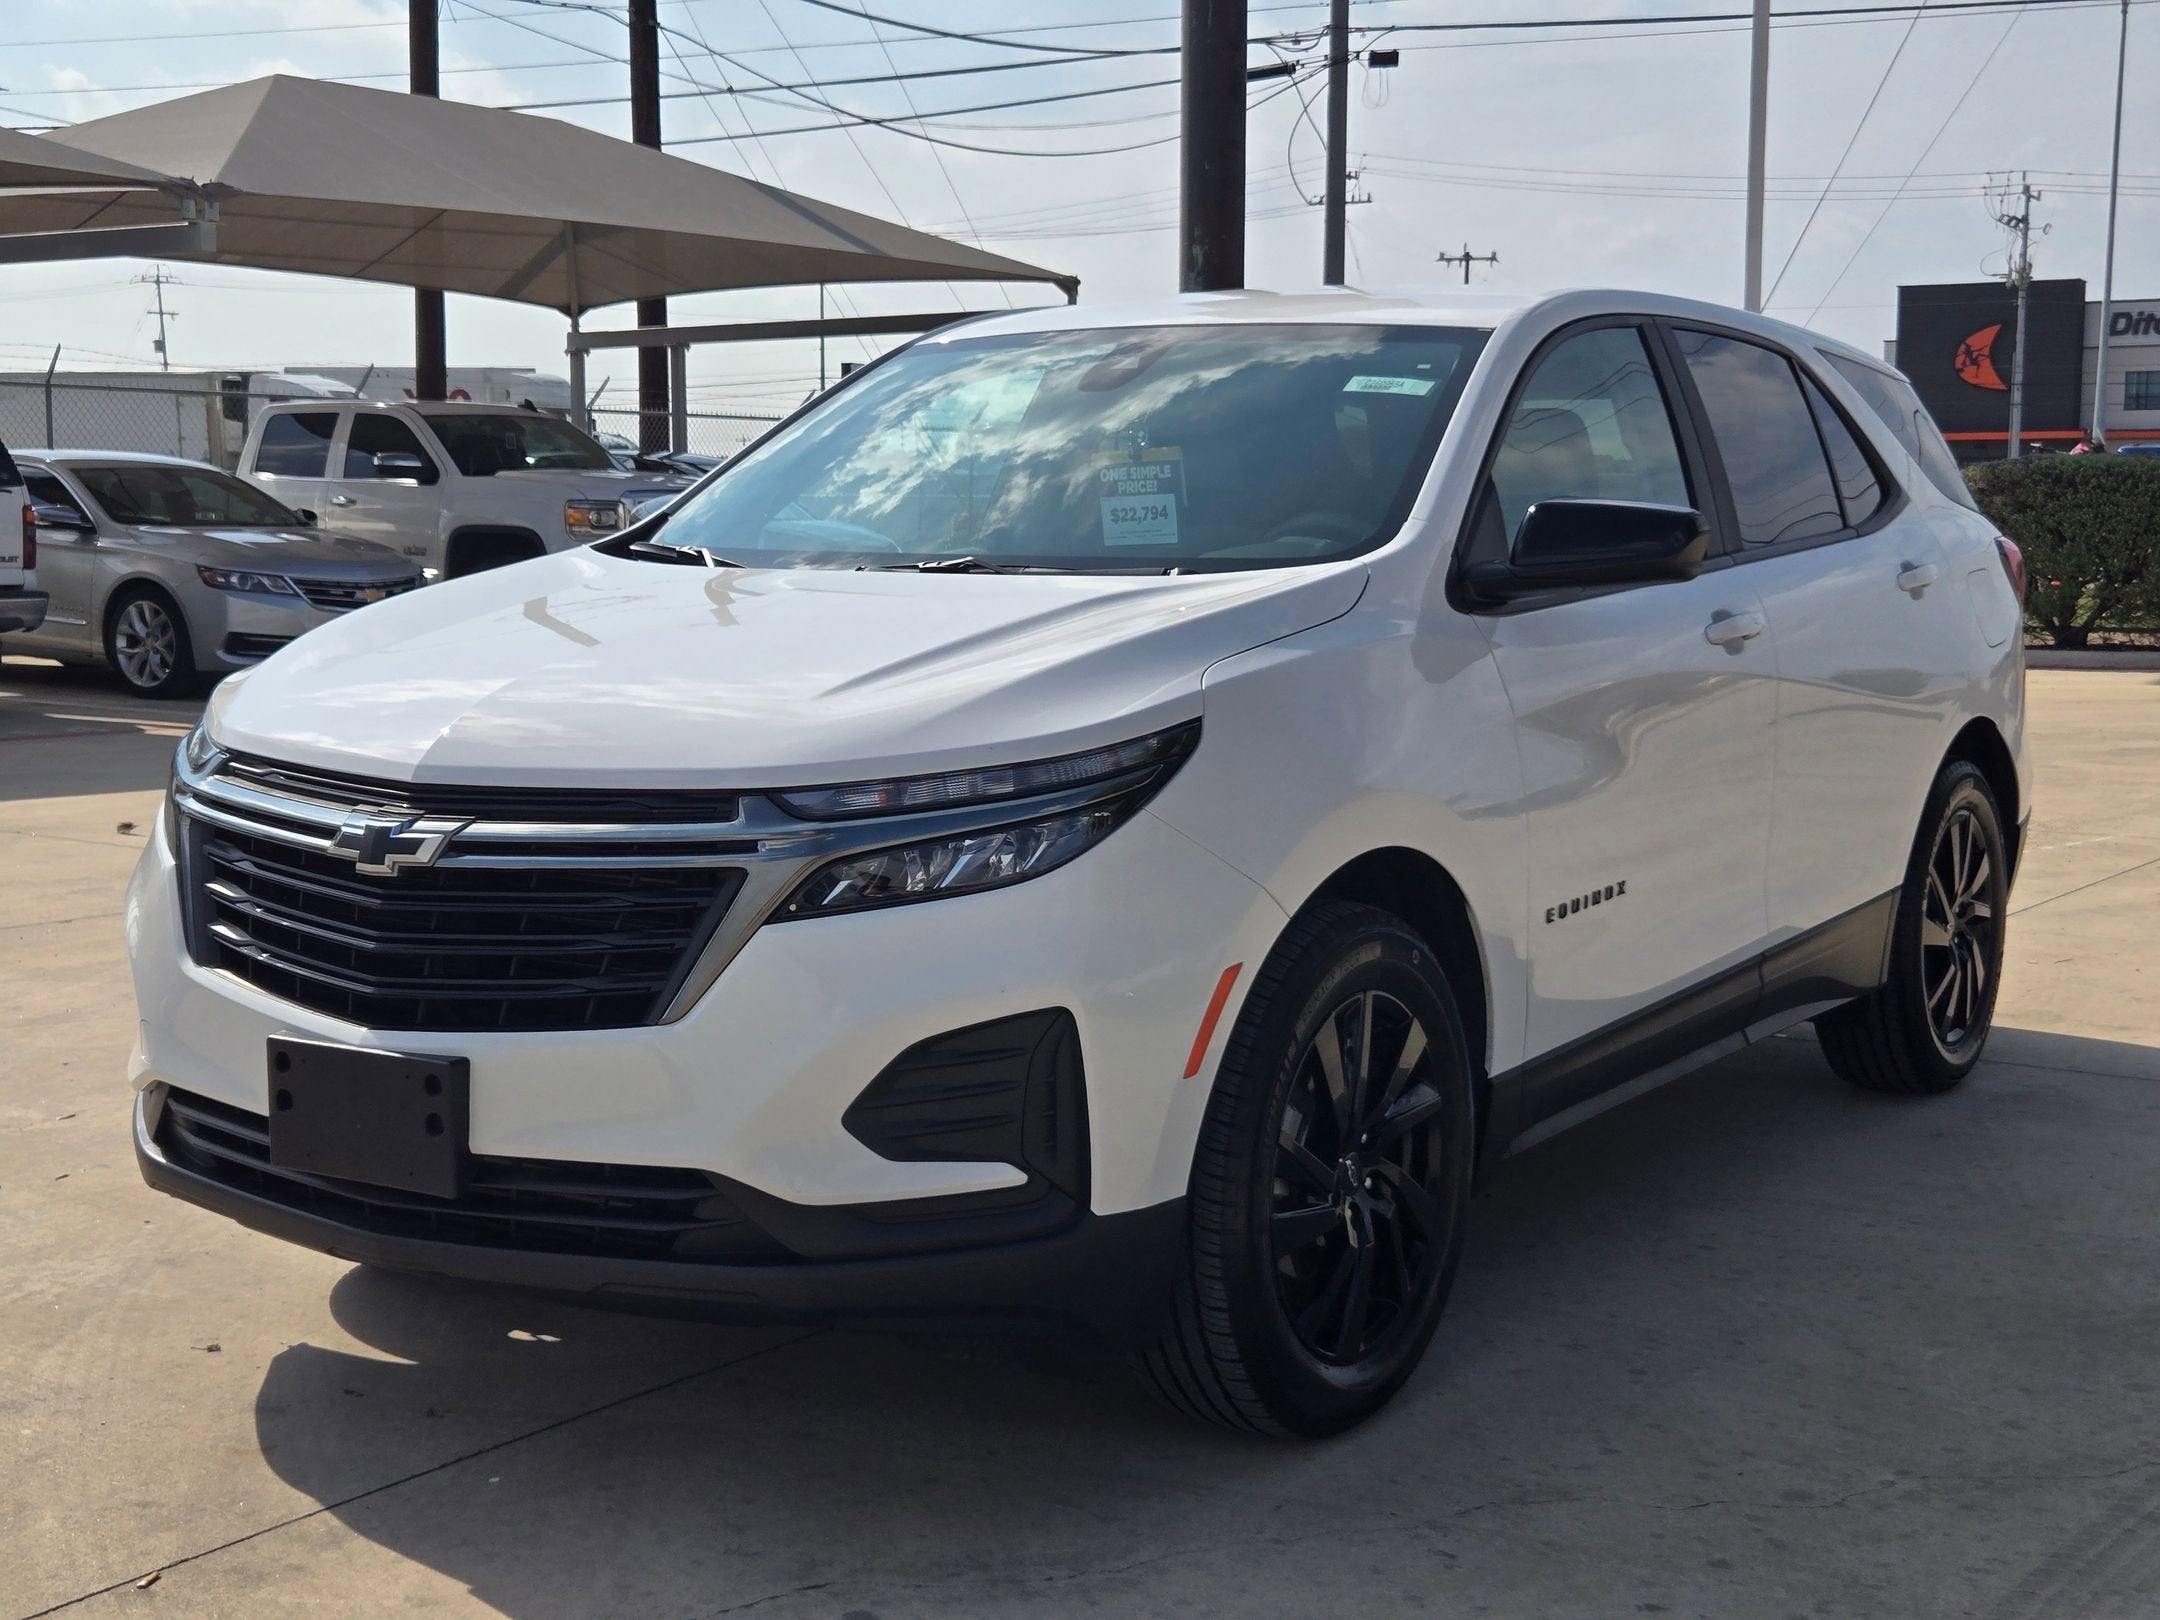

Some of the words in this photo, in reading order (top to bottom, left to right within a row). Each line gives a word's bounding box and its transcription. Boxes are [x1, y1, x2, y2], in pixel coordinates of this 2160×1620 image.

[1100, 467, 1128, 481] ONE
[1130, 464, 1172, 480] SIMPLE
[1118, 480, 1158, 494] PRICE!
[1110, 504, 1169, 524] $22,794
[1545, 880, 1626, 924] EQUINOX
